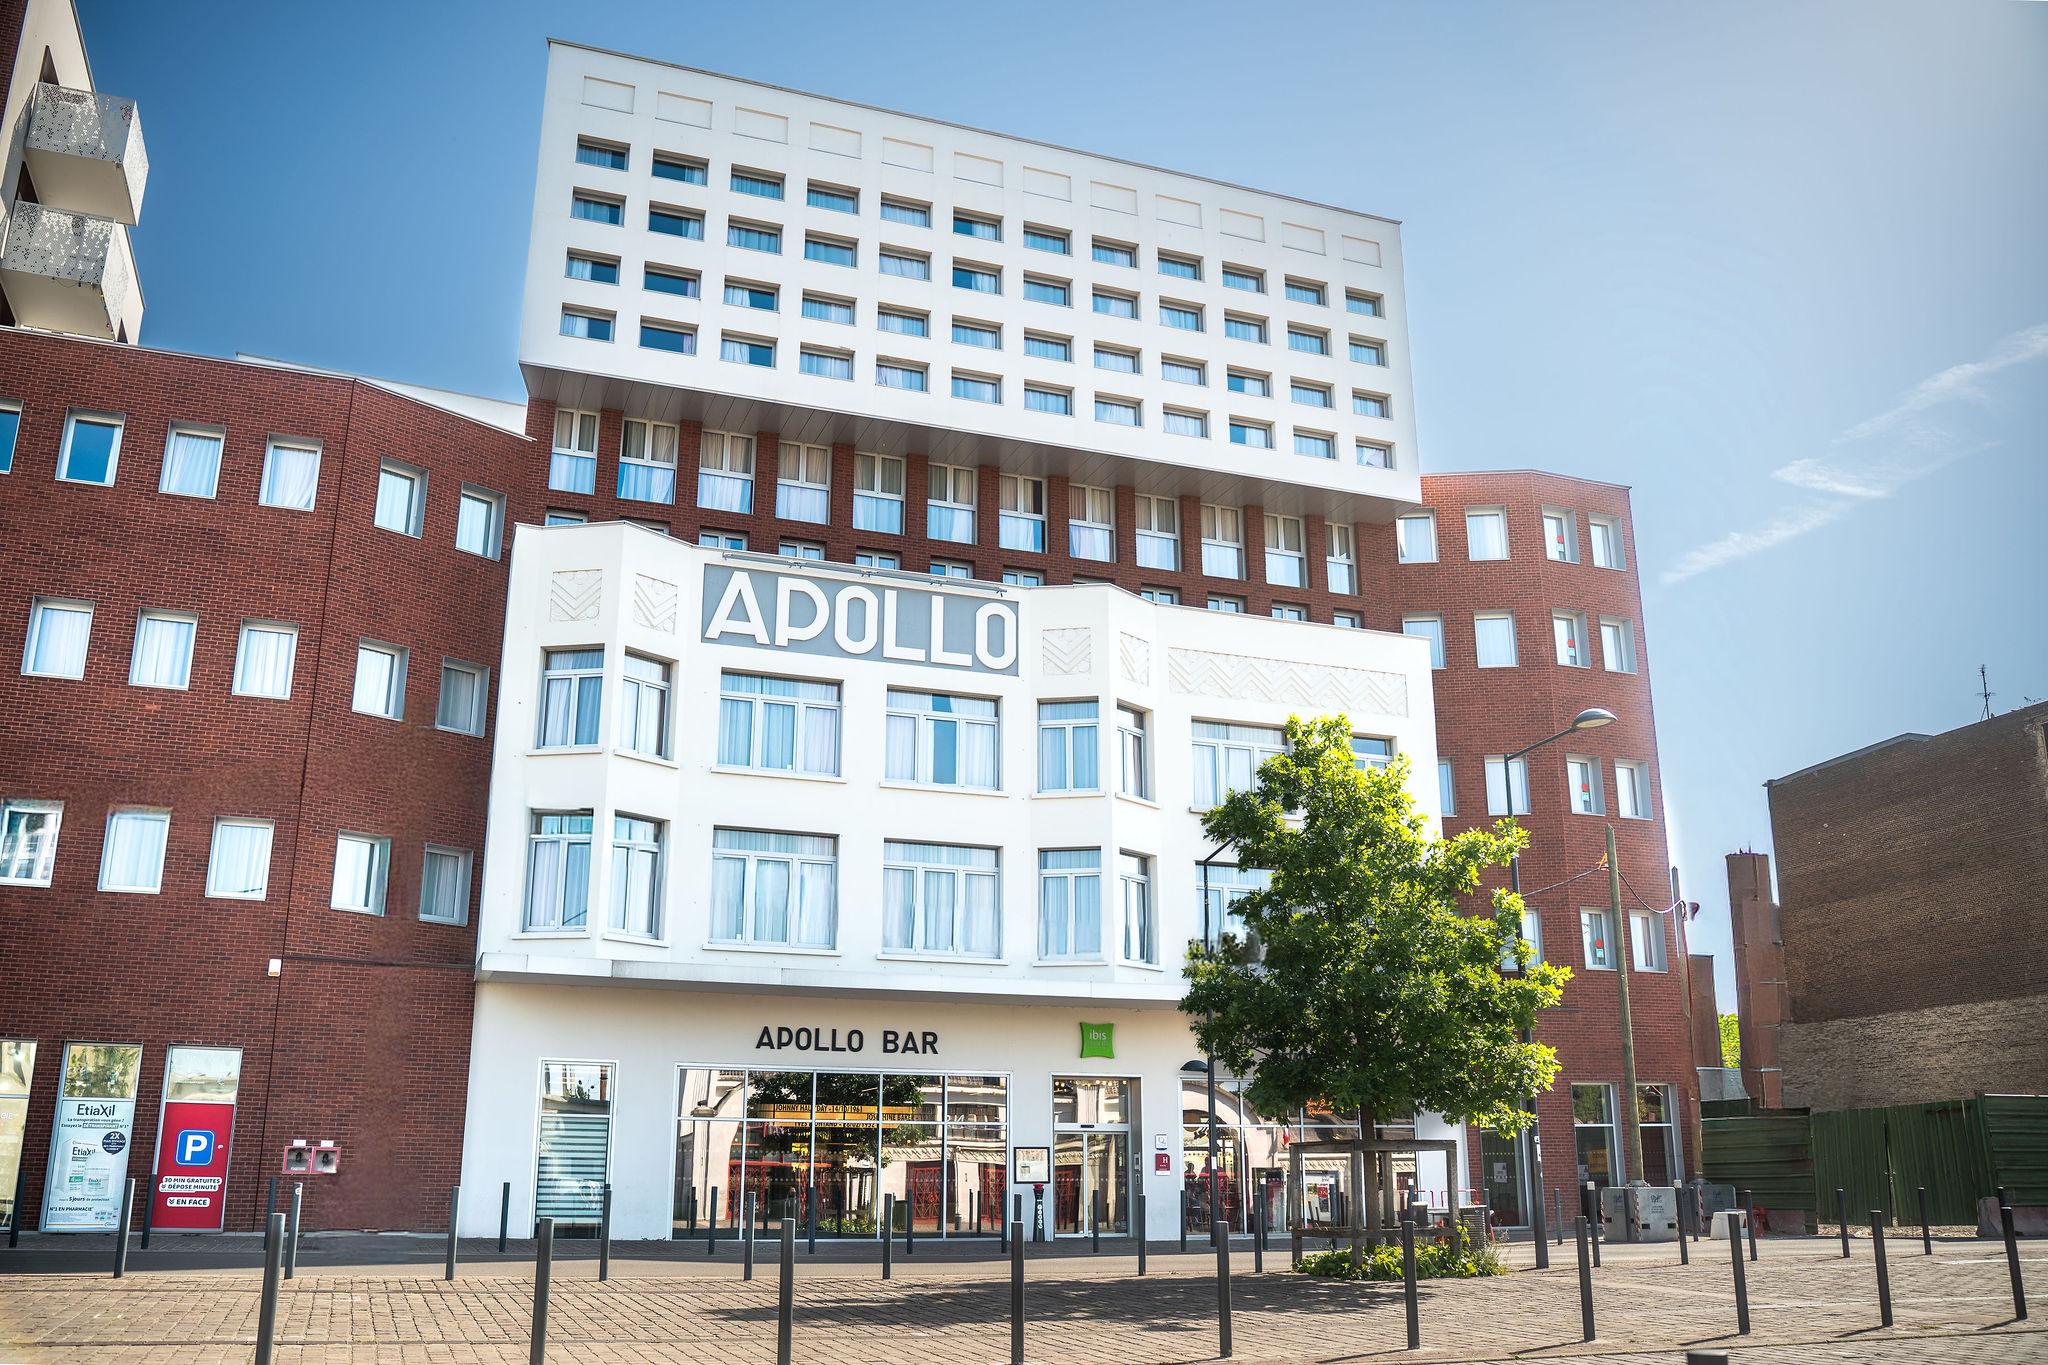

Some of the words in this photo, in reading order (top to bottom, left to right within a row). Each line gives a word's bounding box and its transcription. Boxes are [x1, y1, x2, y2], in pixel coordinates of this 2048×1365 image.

[704, 571, 1017, 670] APOLLO
[755, 1026, 864, 1053] APOLLO
[883, 1030, 939, 1055] BAR
[1089, 1029, 1107, 1041] ibis
[77, 1104, 116, 1118] EtiaXil
[800, 1104, 827, 1112] HALDAY
[184, 1134, 208, 1161] P
